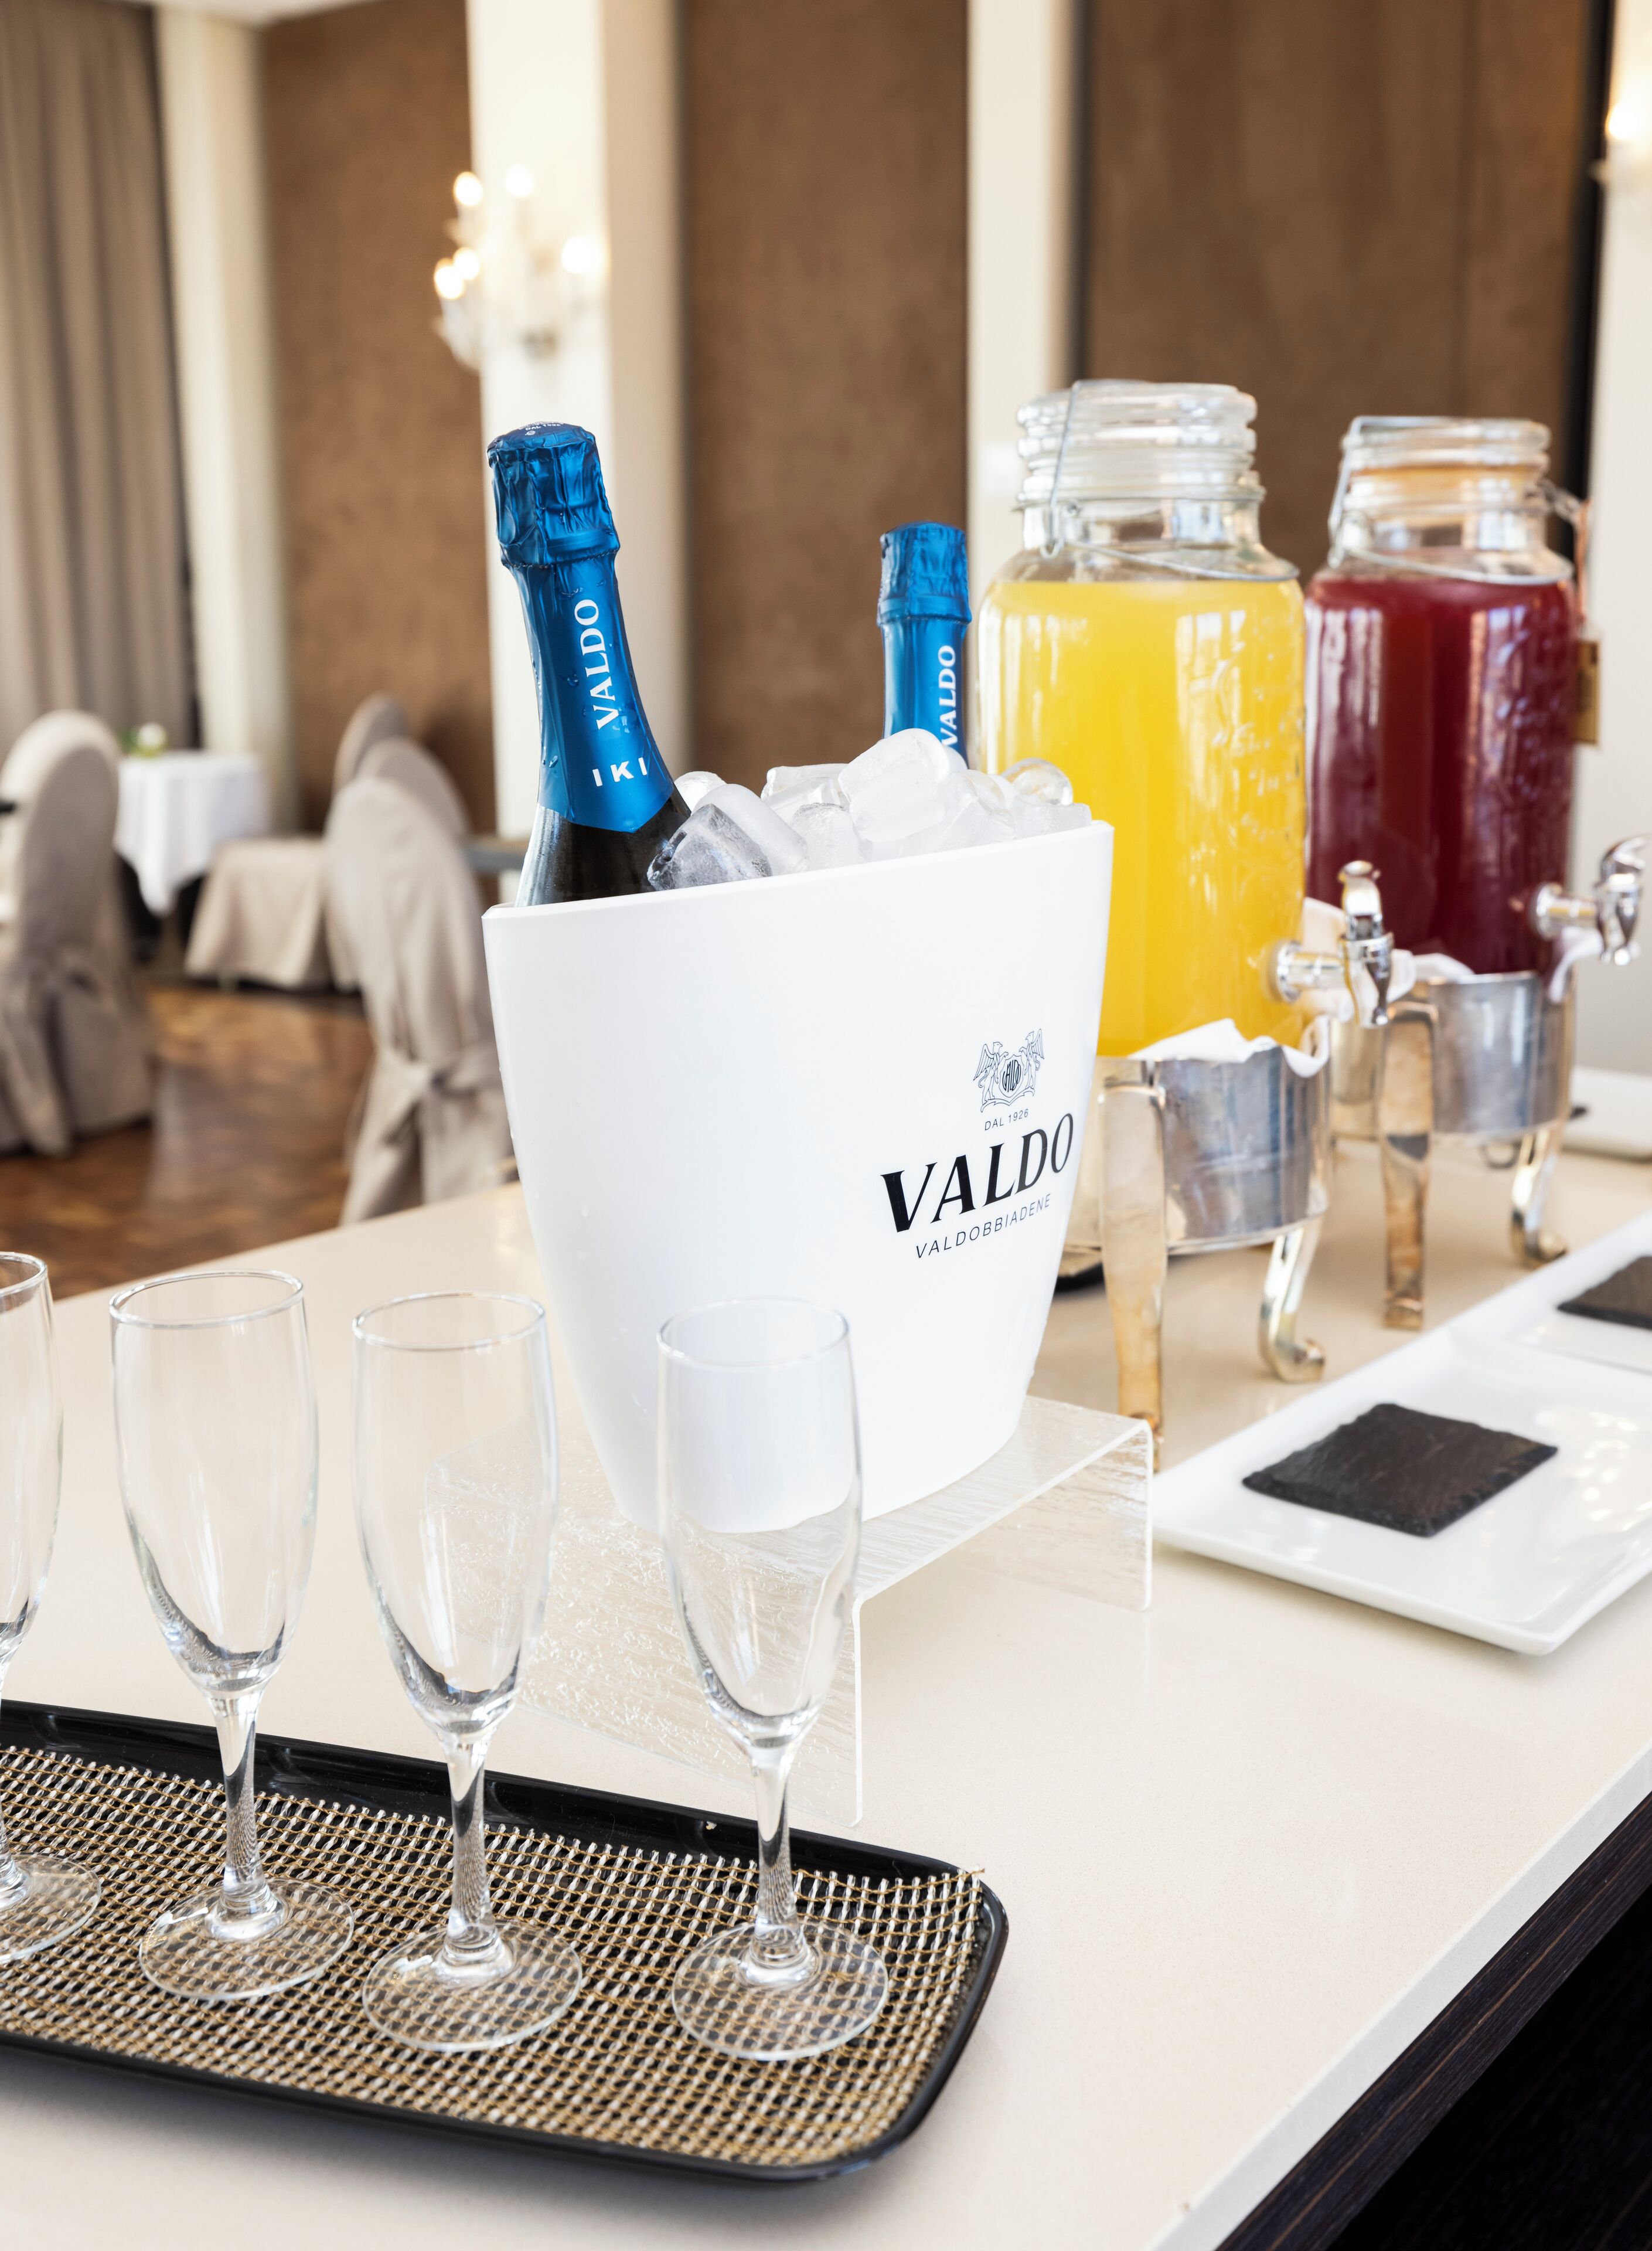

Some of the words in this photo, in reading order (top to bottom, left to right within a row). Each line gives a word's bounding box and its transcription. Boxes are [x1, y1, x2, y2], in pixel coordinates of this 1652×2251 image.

[574, 599, 620, 730] VALDO
[938, 645, 958, 746] VALDO
[592, 757, 648, 787] IKI
[985, 1117, 1004, 1131] DAL
[1009, 1108, 1028, 1123] 1926
[880, 1113, 1074, 1233] VALDO
[915, 1193, 1051, 1259] VALDOBBIADENE
